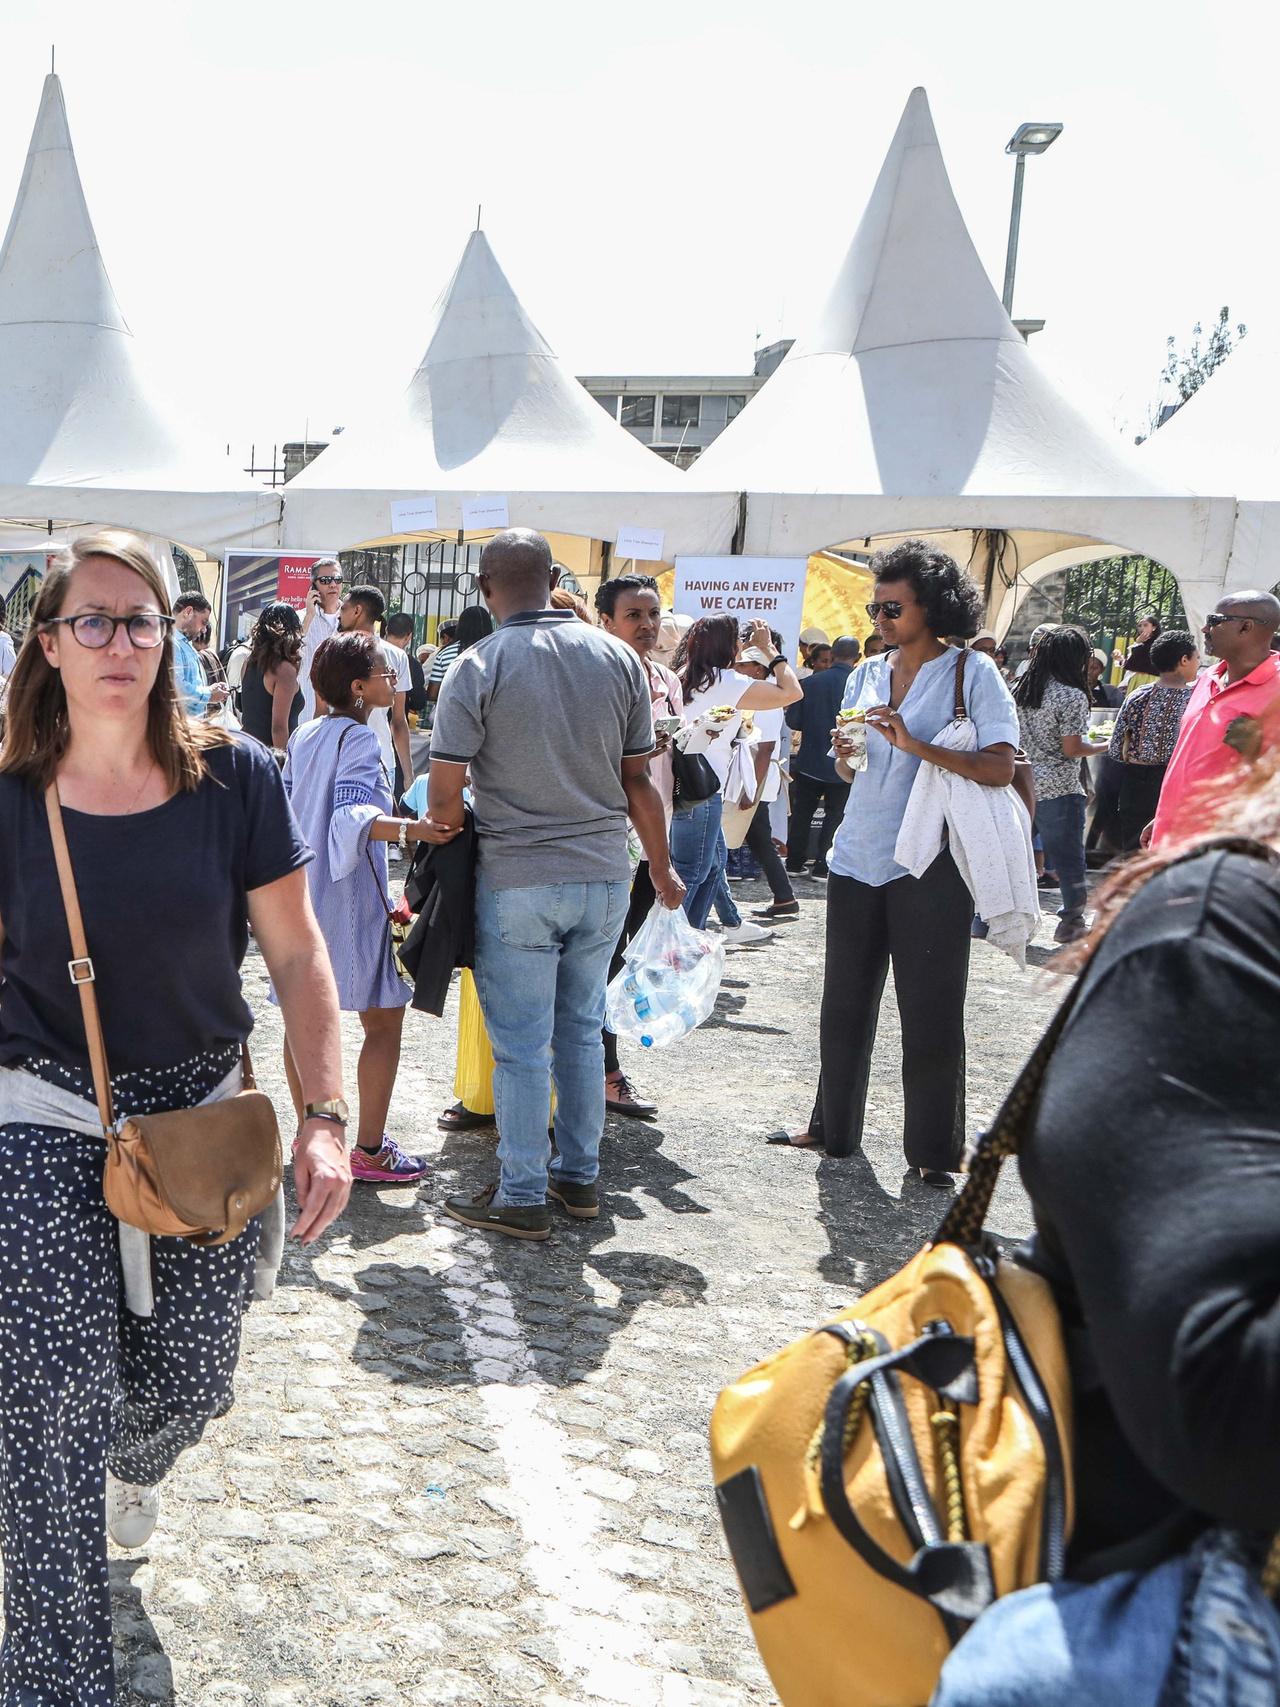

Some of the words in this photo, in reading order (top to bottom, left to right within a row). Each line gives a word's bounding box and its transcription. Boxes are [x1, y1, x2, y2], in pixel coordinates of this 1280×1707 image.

[685, 581, 730, 592] HAVING
[733, 581, 749, 592] AN
[752, 582, 795, 593] EVENT?
[700, 597, 723, 610] WE
[726, 597, 778, 611] CATER!
